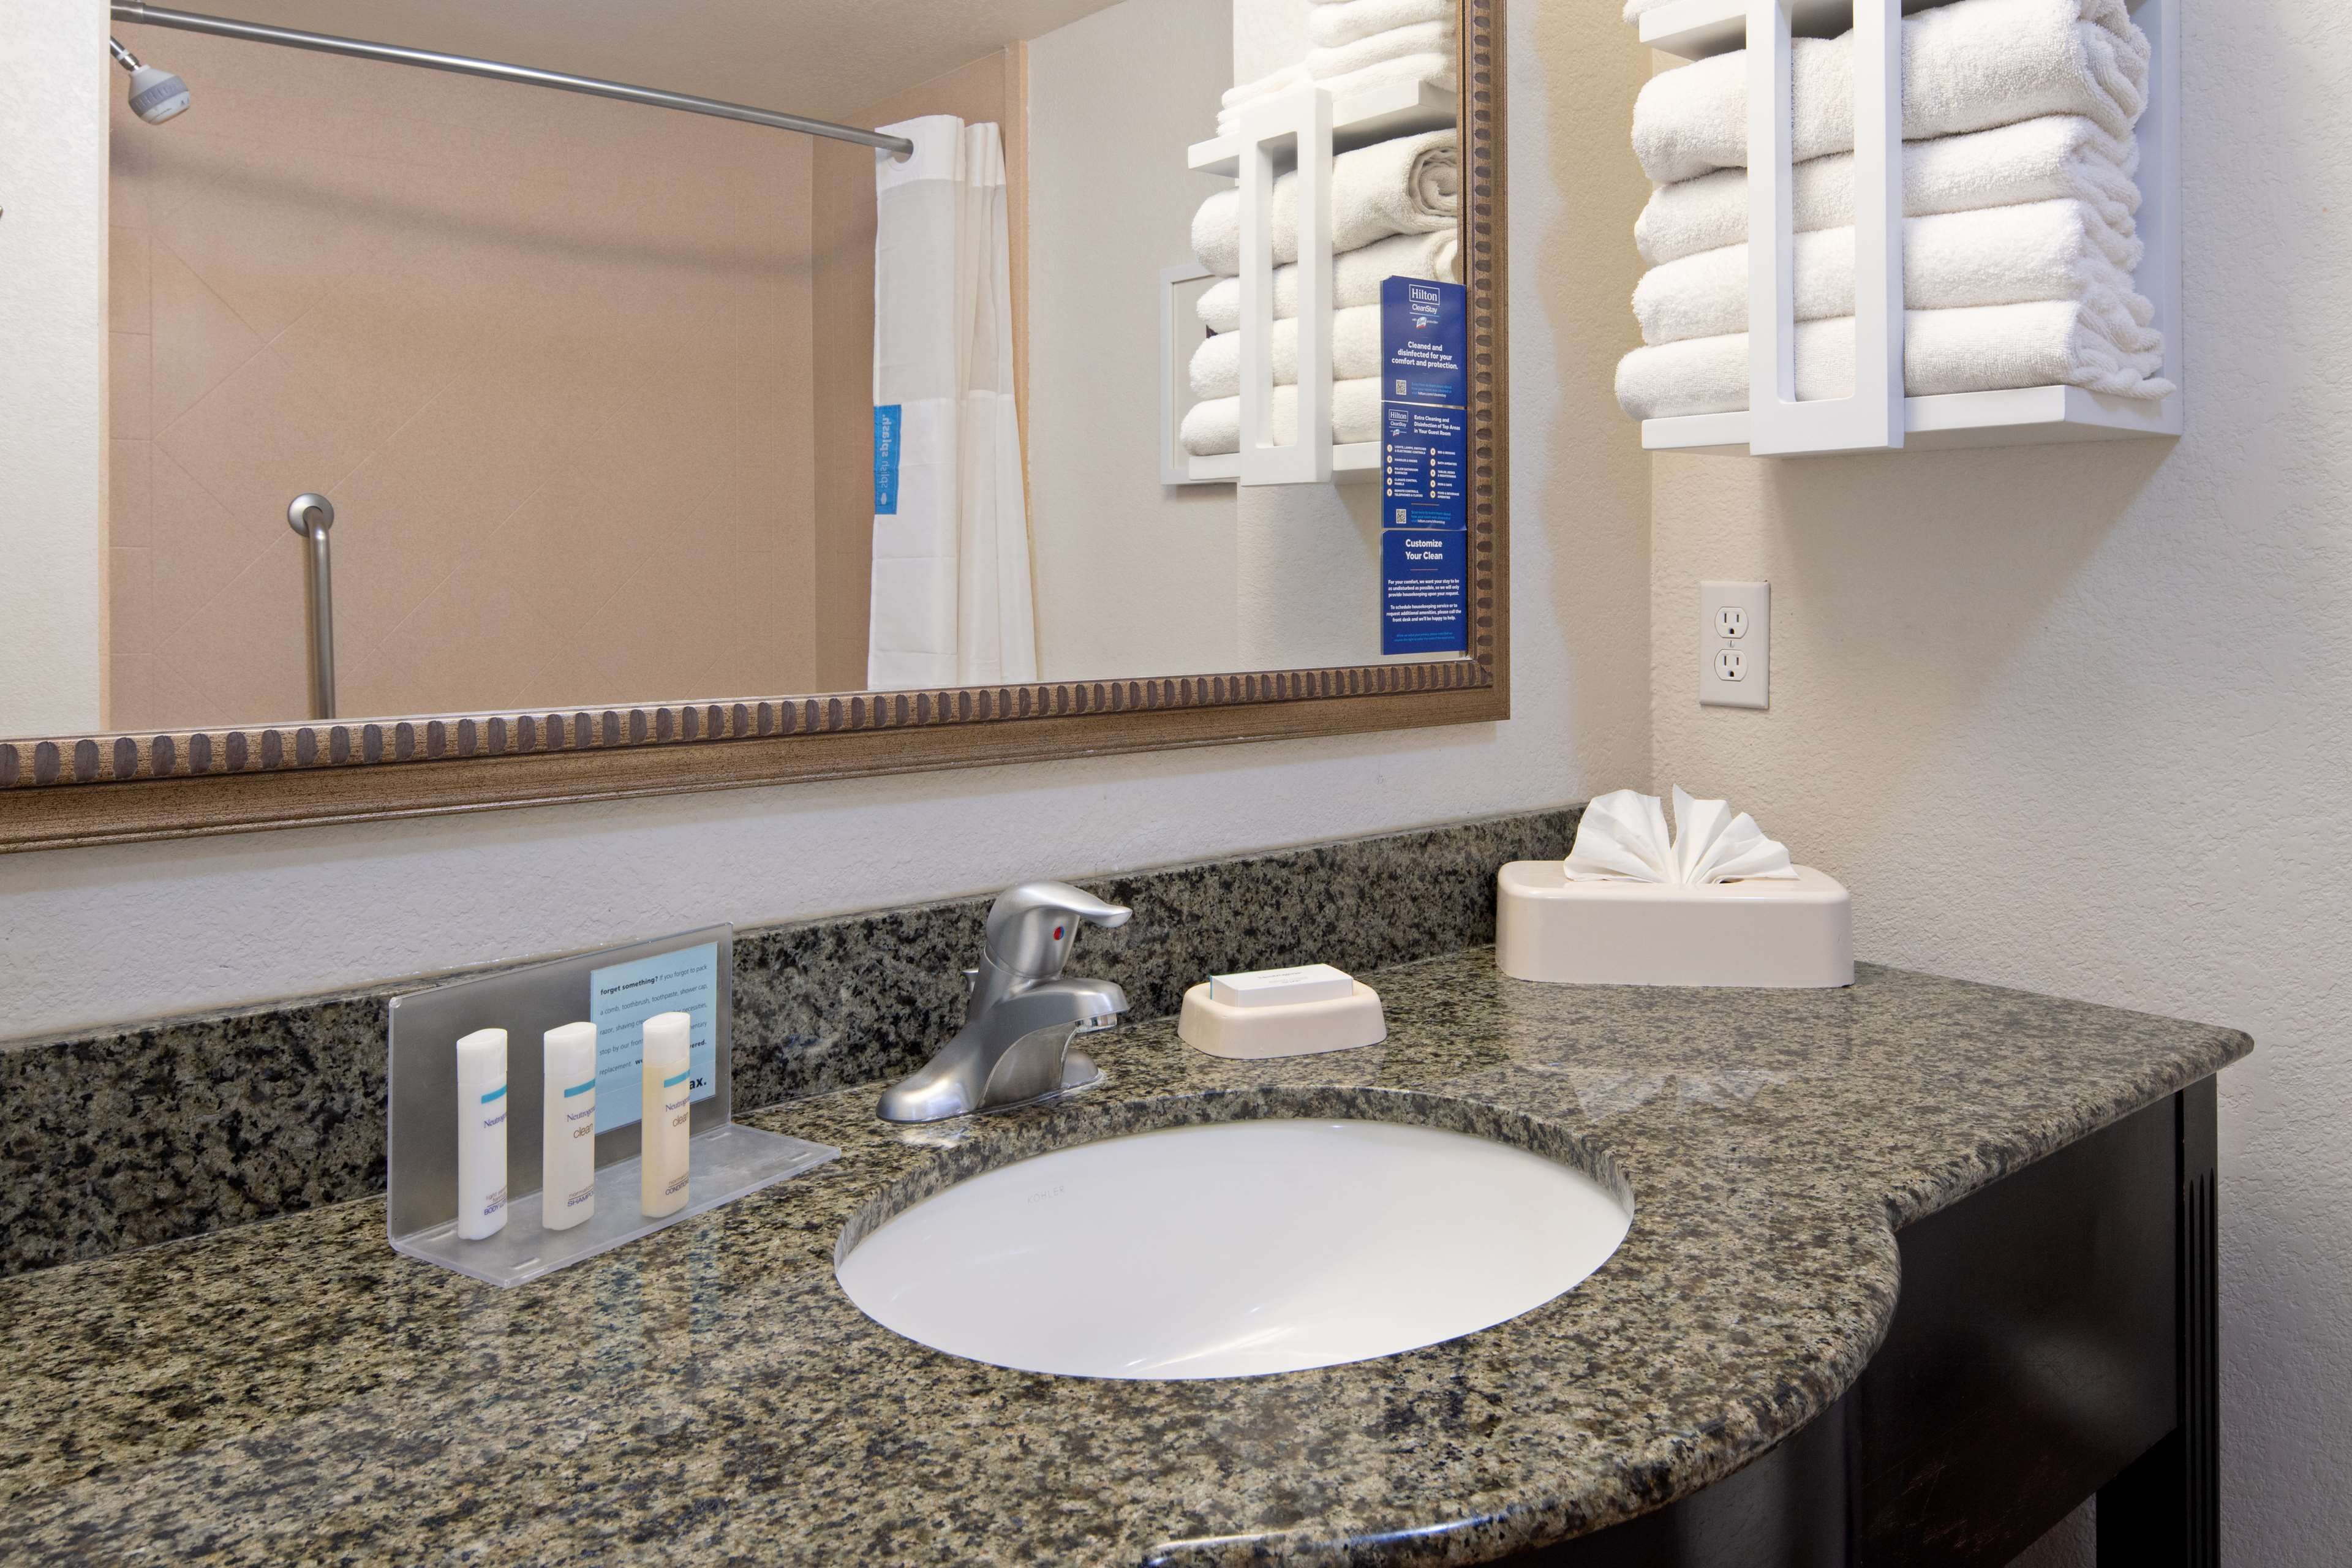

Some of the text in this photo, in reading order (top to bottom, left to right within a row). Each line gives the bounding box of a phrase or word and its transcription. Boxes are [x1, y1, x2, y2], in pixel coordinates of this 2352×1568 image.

[1412, 288, 1438, 301] Hilton
[1412, 304, 1438, 314] CleanStay
[1408, 341, 1431, 350] Cleaned
[1398, 349, 1430, 358] disinfected
[600, 986, 620, 995] forget
[622, 976, 658, 990] something?
[696, 964, 707, 973] pack
[605, 1005, 620, 1014] comb,
[622, 997, 650, 1009] toothbrush,
[652, 992, 679, 1002] toothpaste,
[680, 986, 697, 995] shower
[616, 1022, 635, 1031] shaving
[631, 1038, 643, 1047] front
[690, 1077, 706, 1090] ax.
[573, 1123, 593, 1138] clean
[1028, 1185, 1065, 1205] KOHLER
[484, 1205, 499, 1215] BODY
